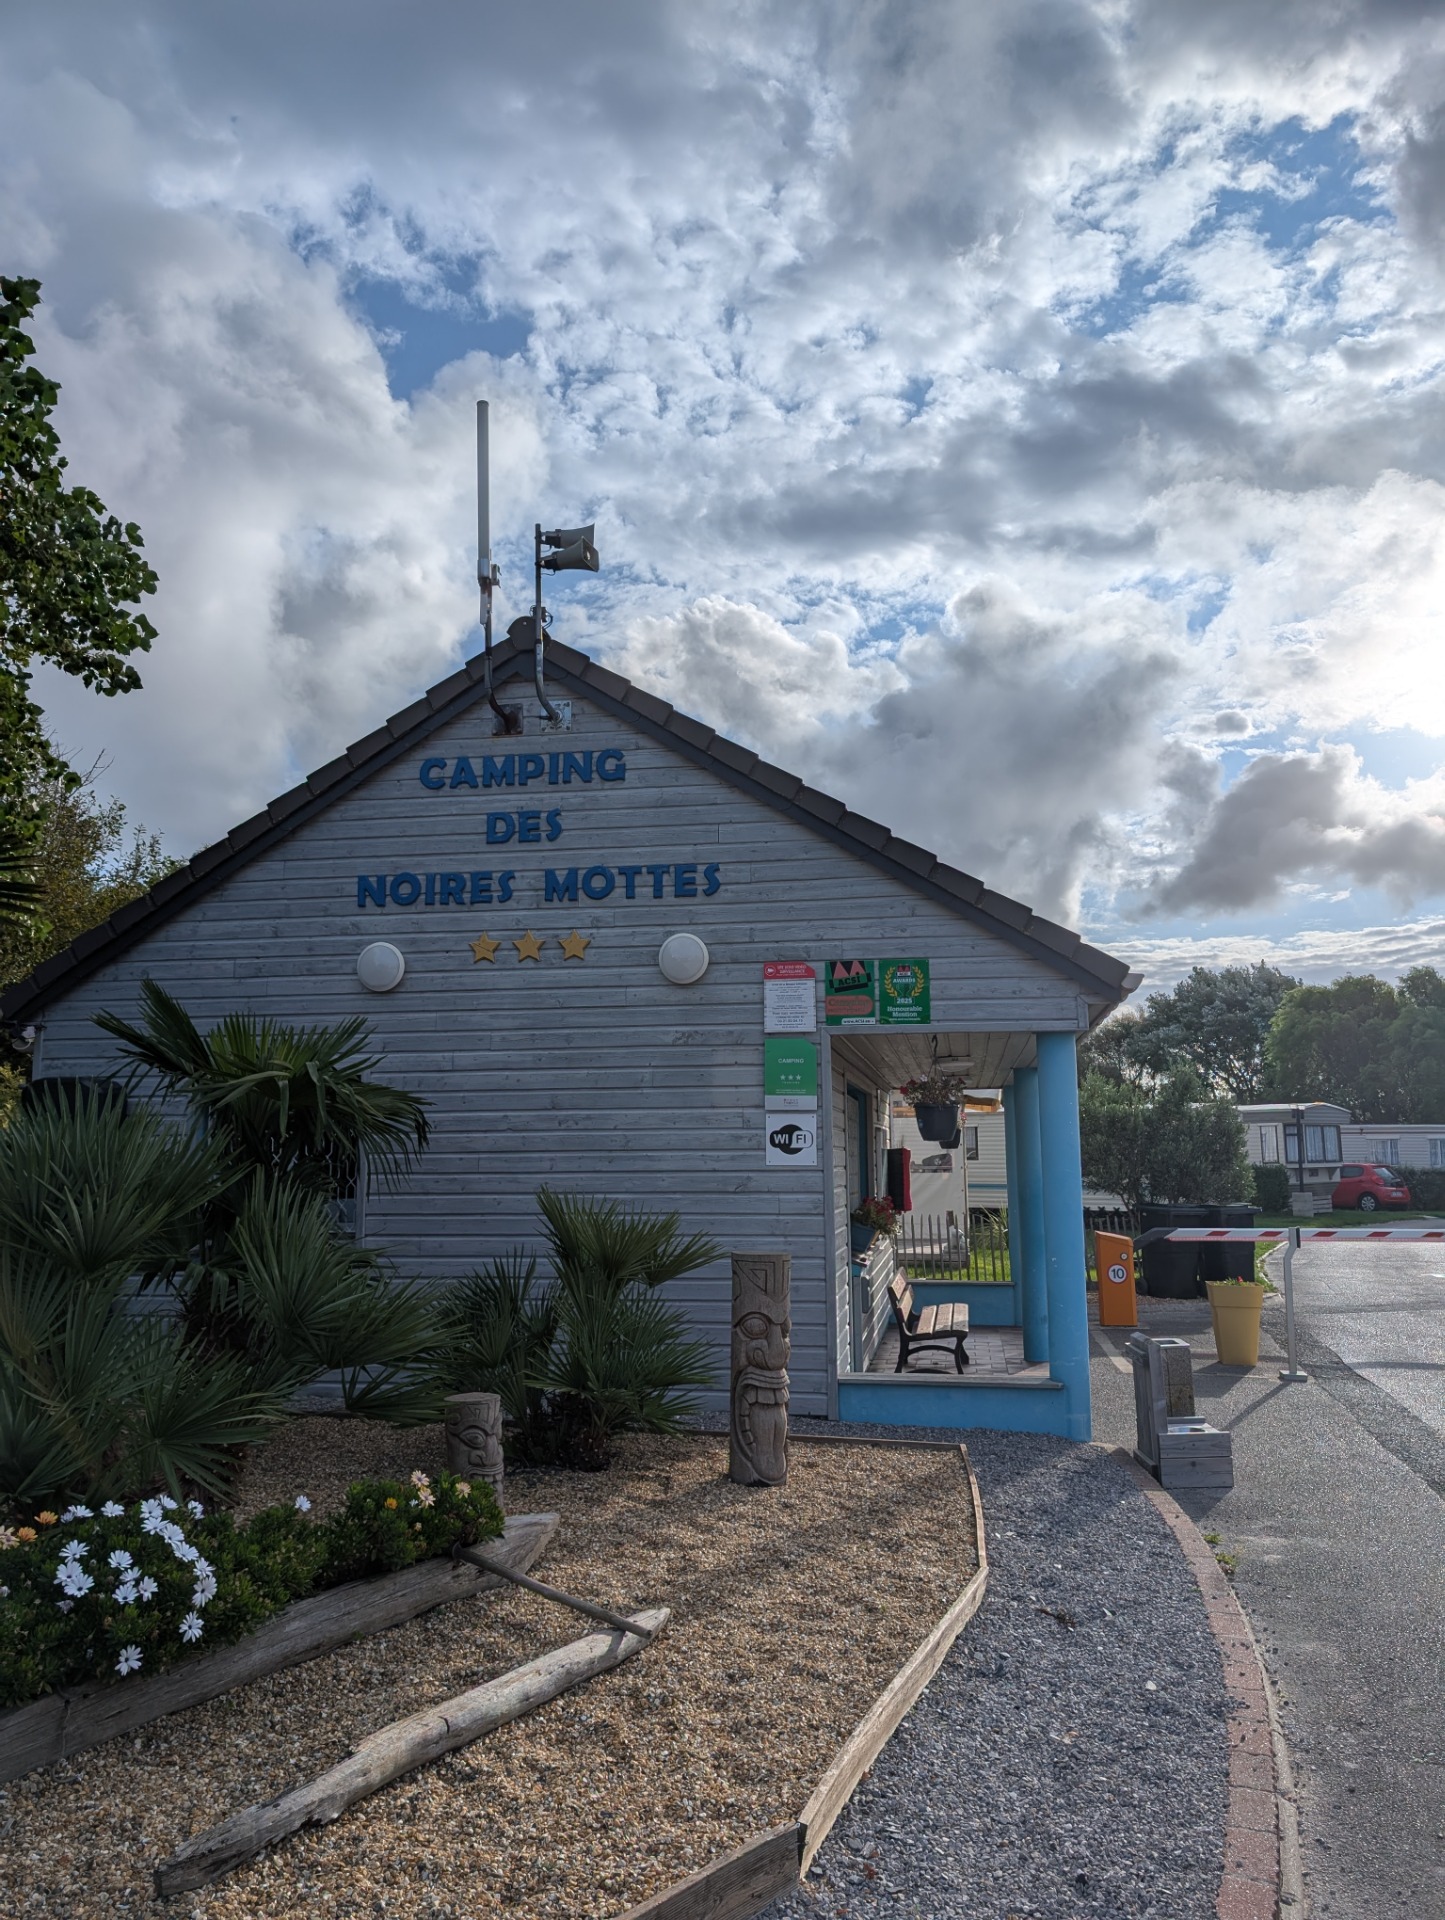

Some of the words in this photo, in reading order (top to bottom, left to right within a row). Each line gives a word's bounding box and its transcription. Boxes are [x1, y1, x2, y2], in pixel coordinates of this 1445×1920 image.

[419, 748, 626, 790] CAMPING
[486, 808, 563, 844] DES
[356, 870, 516, 908] NOIRES
[544, 863, 720, 902] MOTTES
[1111, 1268, 1125, 1279] 10
